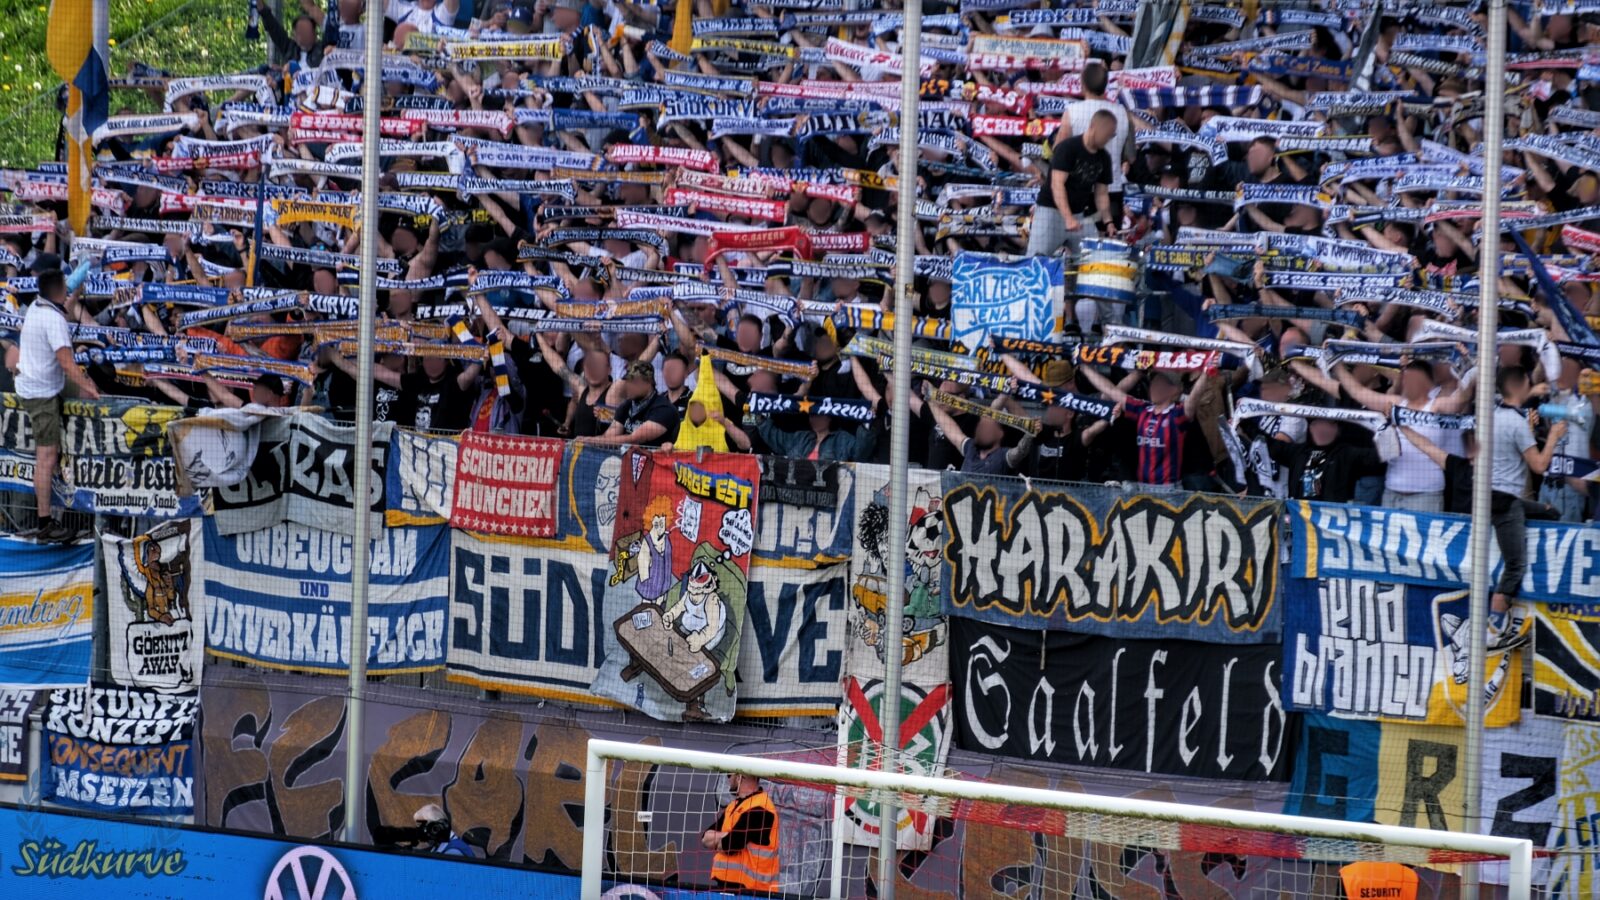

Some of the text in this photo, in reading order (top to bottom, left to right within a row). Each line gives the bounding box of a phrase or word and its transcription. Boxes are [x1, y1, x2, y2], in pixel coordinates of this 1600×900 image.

[1010, 11, 1097, 24] SÜDKU
[301, 115, 411, 132] SÜDKVE
[1280, 137, 1372, 152] UNBEUGSAM
[500, 154, 524, 162] CARL
[529, 155, 557, 164] ZEISS
[560, 158, 587, 166] JENA
[202, 181, 308, 199] SÜDKRVE
[399, 173, 458, 187] UNBEUGSA
[261, 245, 308, 261] DKURVE
[673, 282, 717, 297] WEIMAR
[308, 294, 358, 316] KURVE
[969, 304, 1010, 326] JENA
[1155, 351, 1205, 369] RAS
[1136, 435, 1166, 447] OPEL
[459, 446, 555, 484] SCHICKERIA
[456, 479, 552, 519] MÜNCHEN
[715, 478, 752, 509] EST
[236, 520, 418, 577] UNBEUGAM
[947, 486, 1277, 627] HARAKIRI
[299, 581, 330, 599] UND
[452, 547, 845, 684] SÜDVE
[138, 654, 180, 677] AWAY
[964, 634, 1287, 776] Saalfeld
[47, 704, 189, 745] KONZEPT
[50, 735, 190, 777] ONSEQUENT
[1360, 887, 1403, 899] SECURITY
